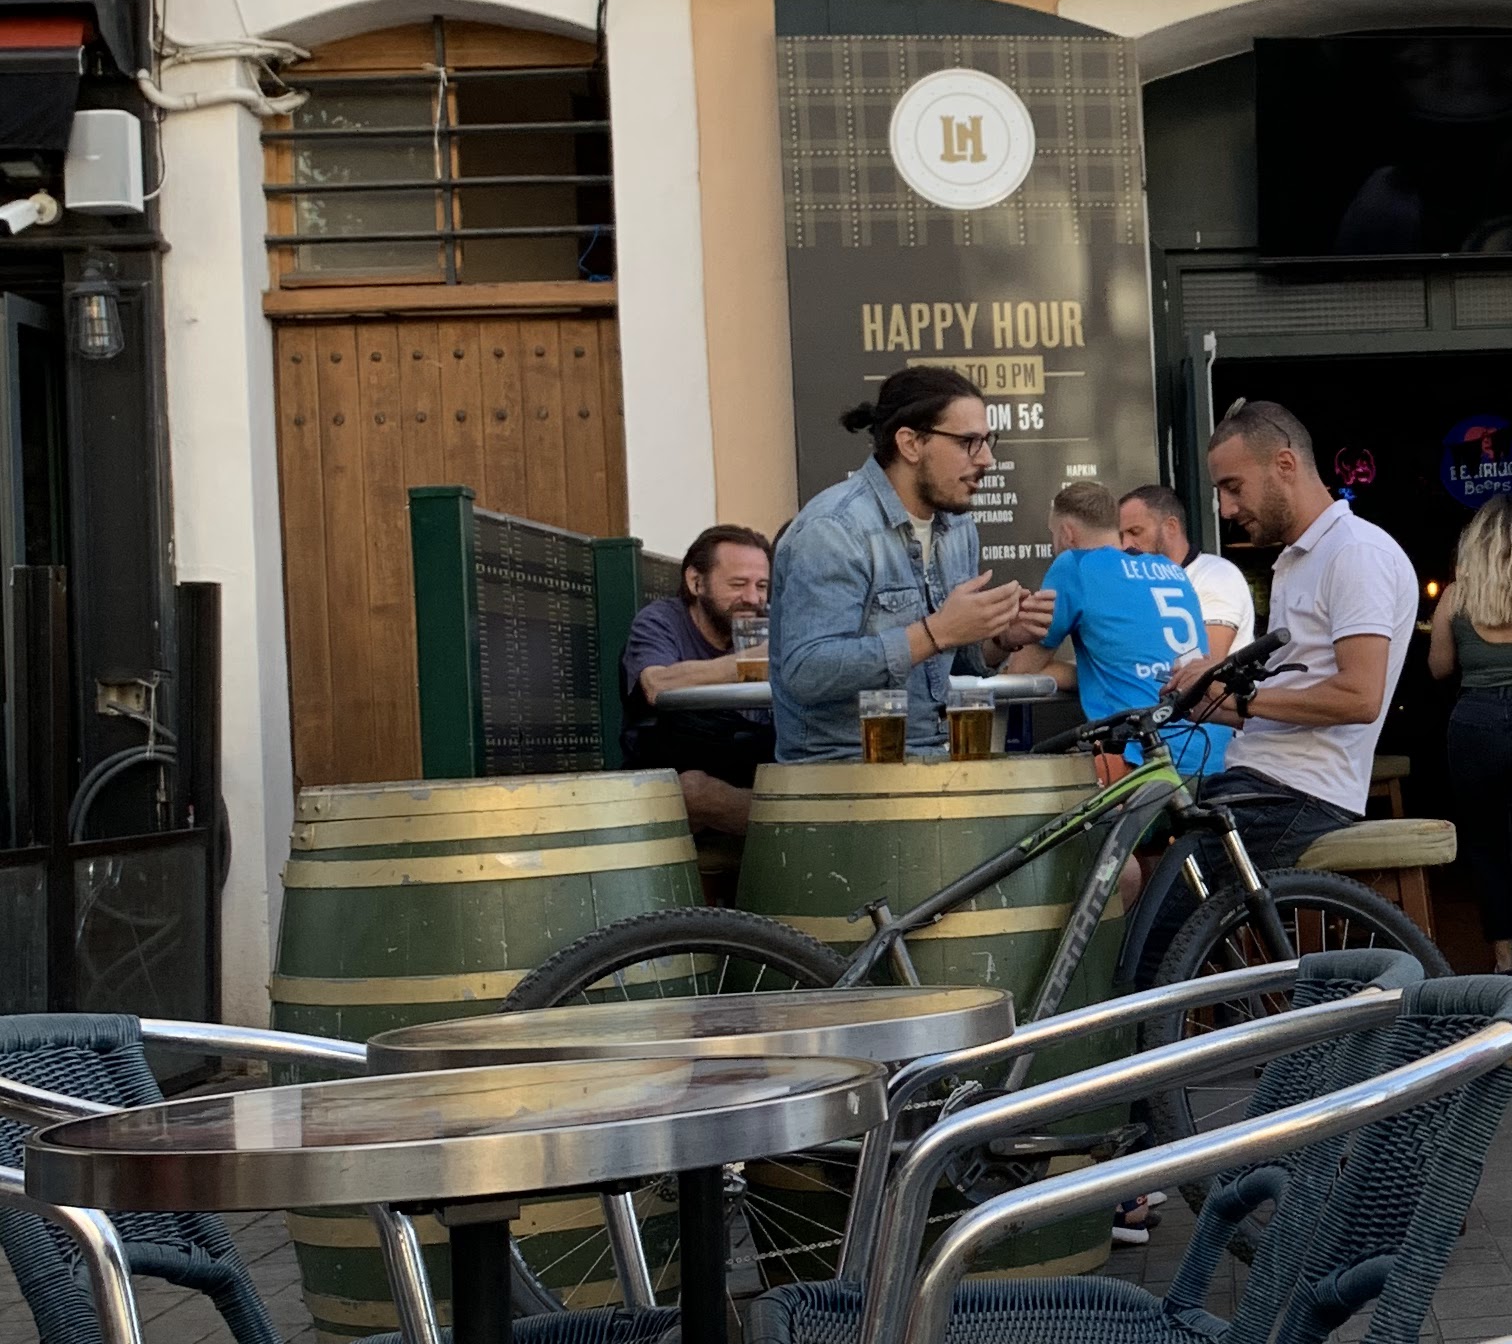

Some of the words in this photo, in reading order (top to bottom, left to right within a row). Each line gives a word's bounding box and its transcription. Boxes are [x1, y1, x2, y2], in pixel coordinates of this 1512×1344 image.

[862, 303, 978, 352] HAPPY
[992, 301, 1085, 349] HOUR
[985, 404, 1011, 431] OM
[1019, 403, 1044, 430] 5€
[978, 474, 1005, 488] STER'S
[971, 492, 1001, 505] UNITAS
[971, 510, 1013, 523] ESPERADOS
[982, 545, 1016, 560] CIDERS
[1150, 587, 1198, 655] 5
